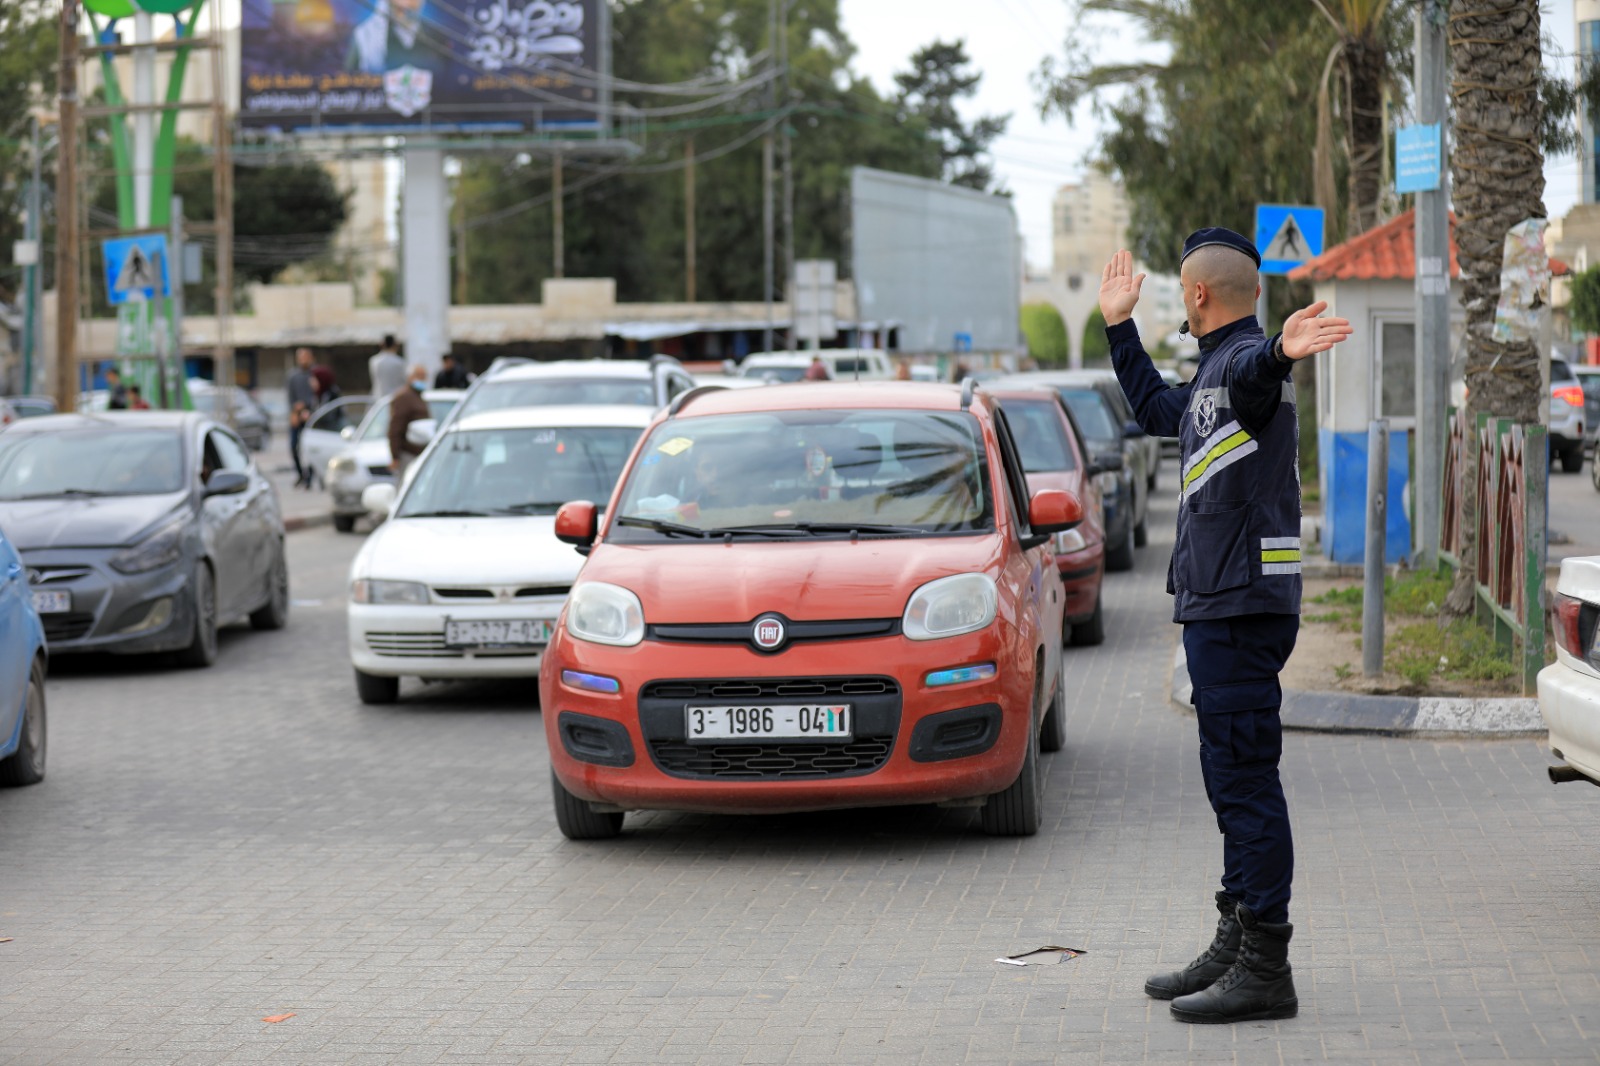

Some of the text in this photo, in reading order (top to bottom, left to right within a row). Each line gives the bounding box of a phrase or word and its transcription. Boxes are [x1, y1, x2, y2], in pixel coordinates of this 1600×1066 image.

[470, 0, 585, 34] رمضان
[469, 28, 585, 70] كريم
[761, 627, 778, 640] FIAT
